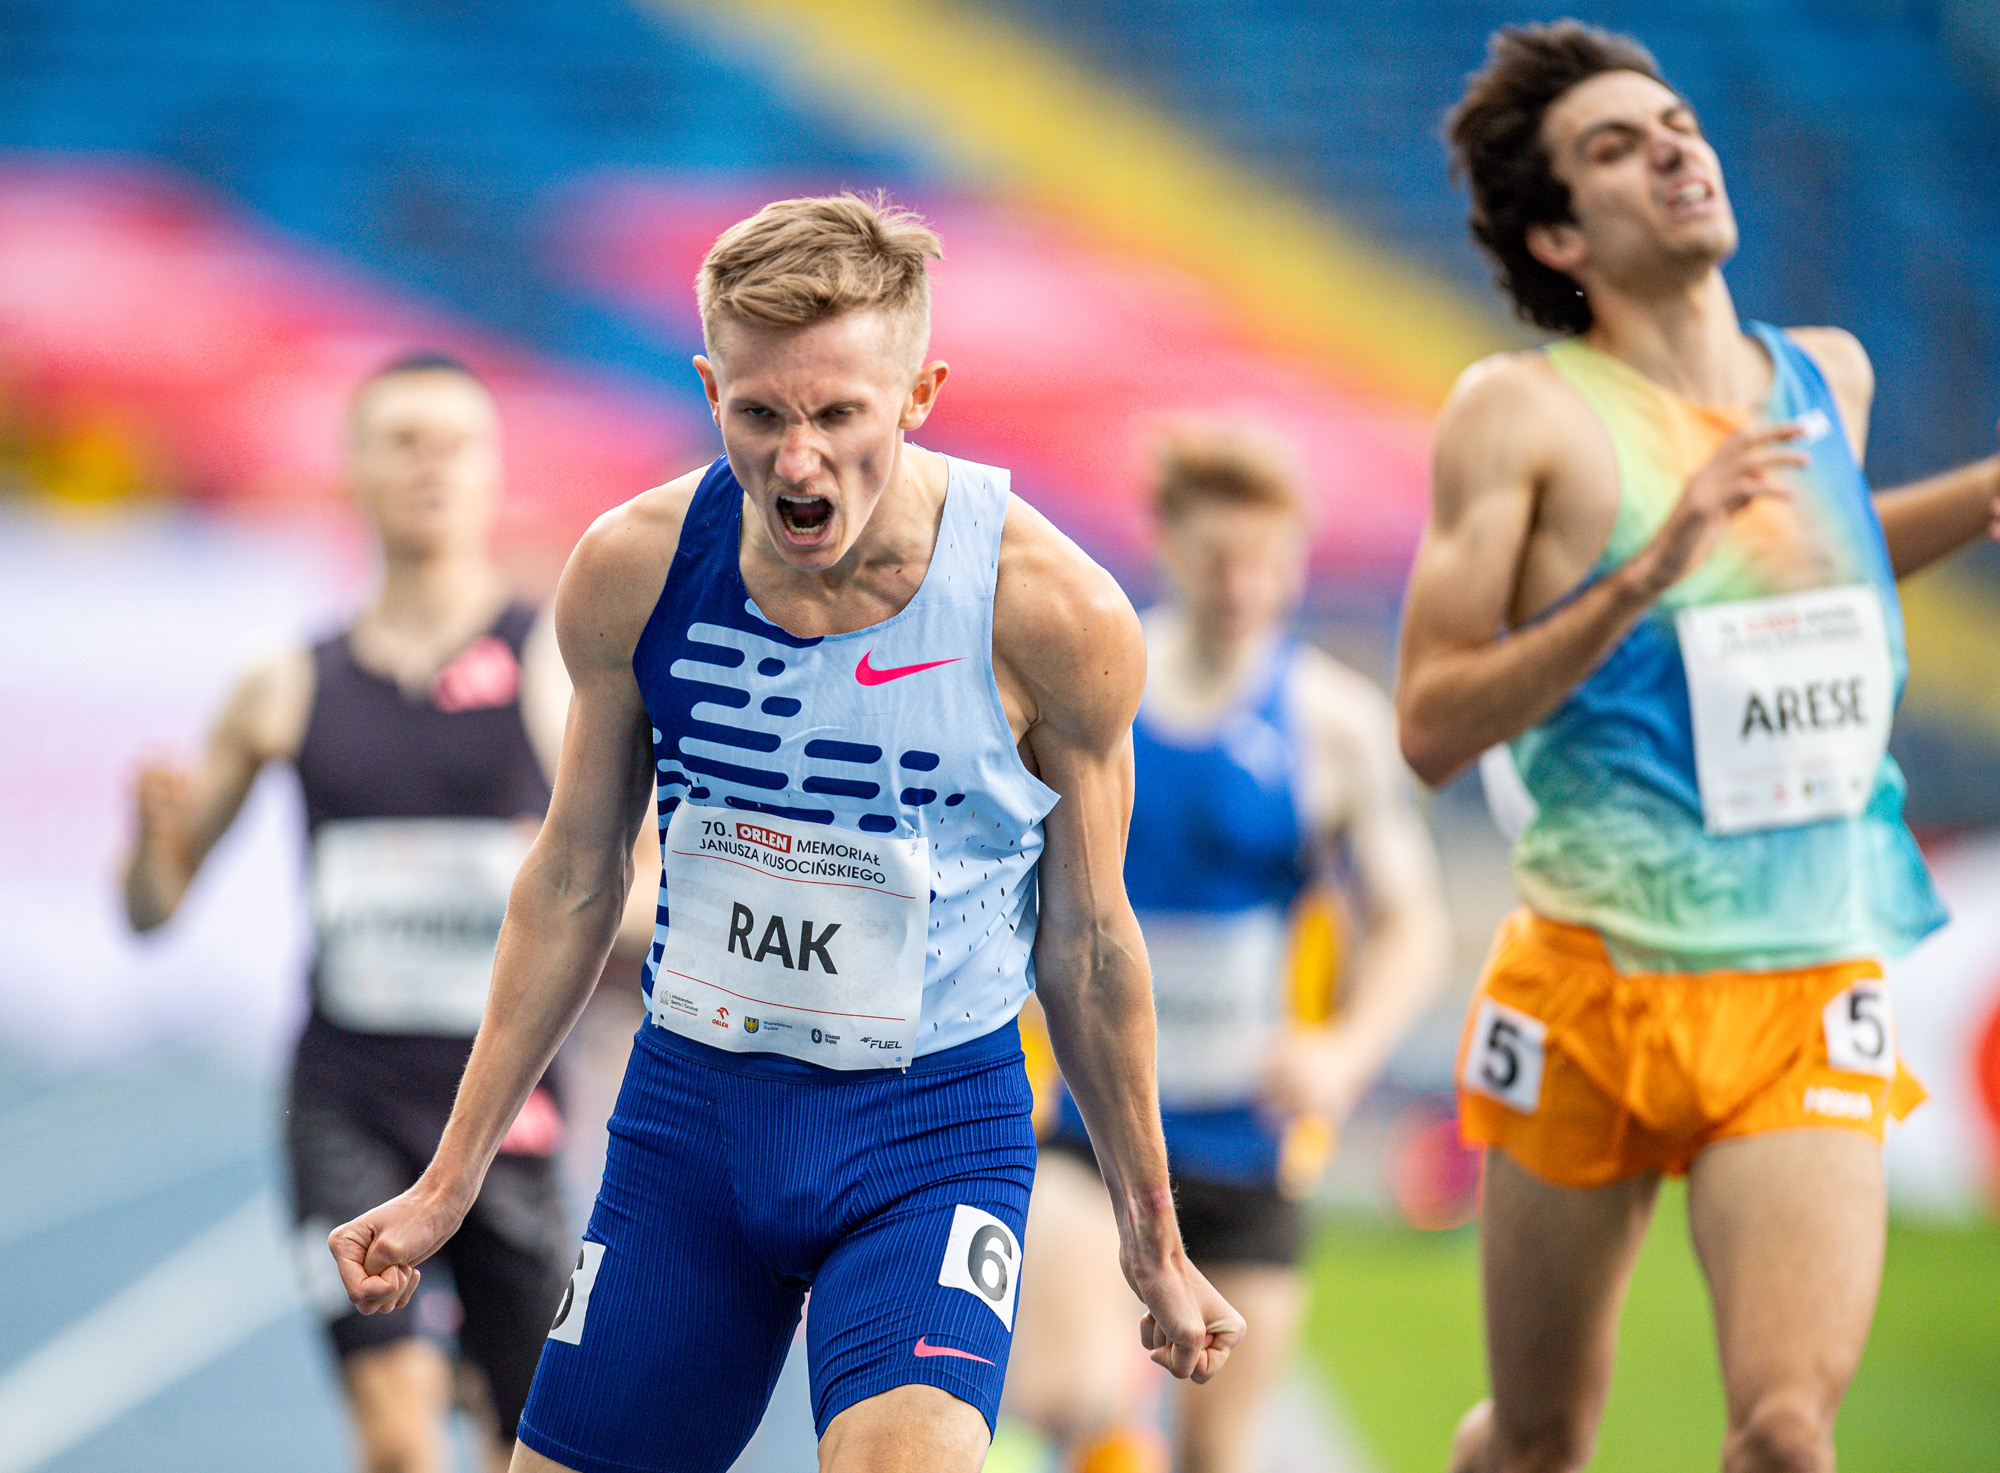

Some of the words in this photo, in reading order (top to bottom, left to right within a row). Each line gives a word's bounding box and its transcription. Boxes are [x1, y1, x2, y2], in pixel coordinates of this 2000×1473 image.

[1740, 677, 1866, 740] ARESE
[699, 838, 760, 862] JANUSZA
[762, 853, 886, 884] KUSOCIŃSKIEGO
[701, 821, 732, 837] 70.
[739, 825, 788, 851] ORLEN
[797, 839, 881, 866] MEMORIAŁ
[727, 901, 842, 975] RAK
[712, 1019, 729, 1029] ORLEN
[869, 1040, 902, 1049] FUEL
[1480, 1015, 1520, 1090] 5
[1848, 988, 1886, 1061] 5
[967, 1224, 1013, 1302] 6
